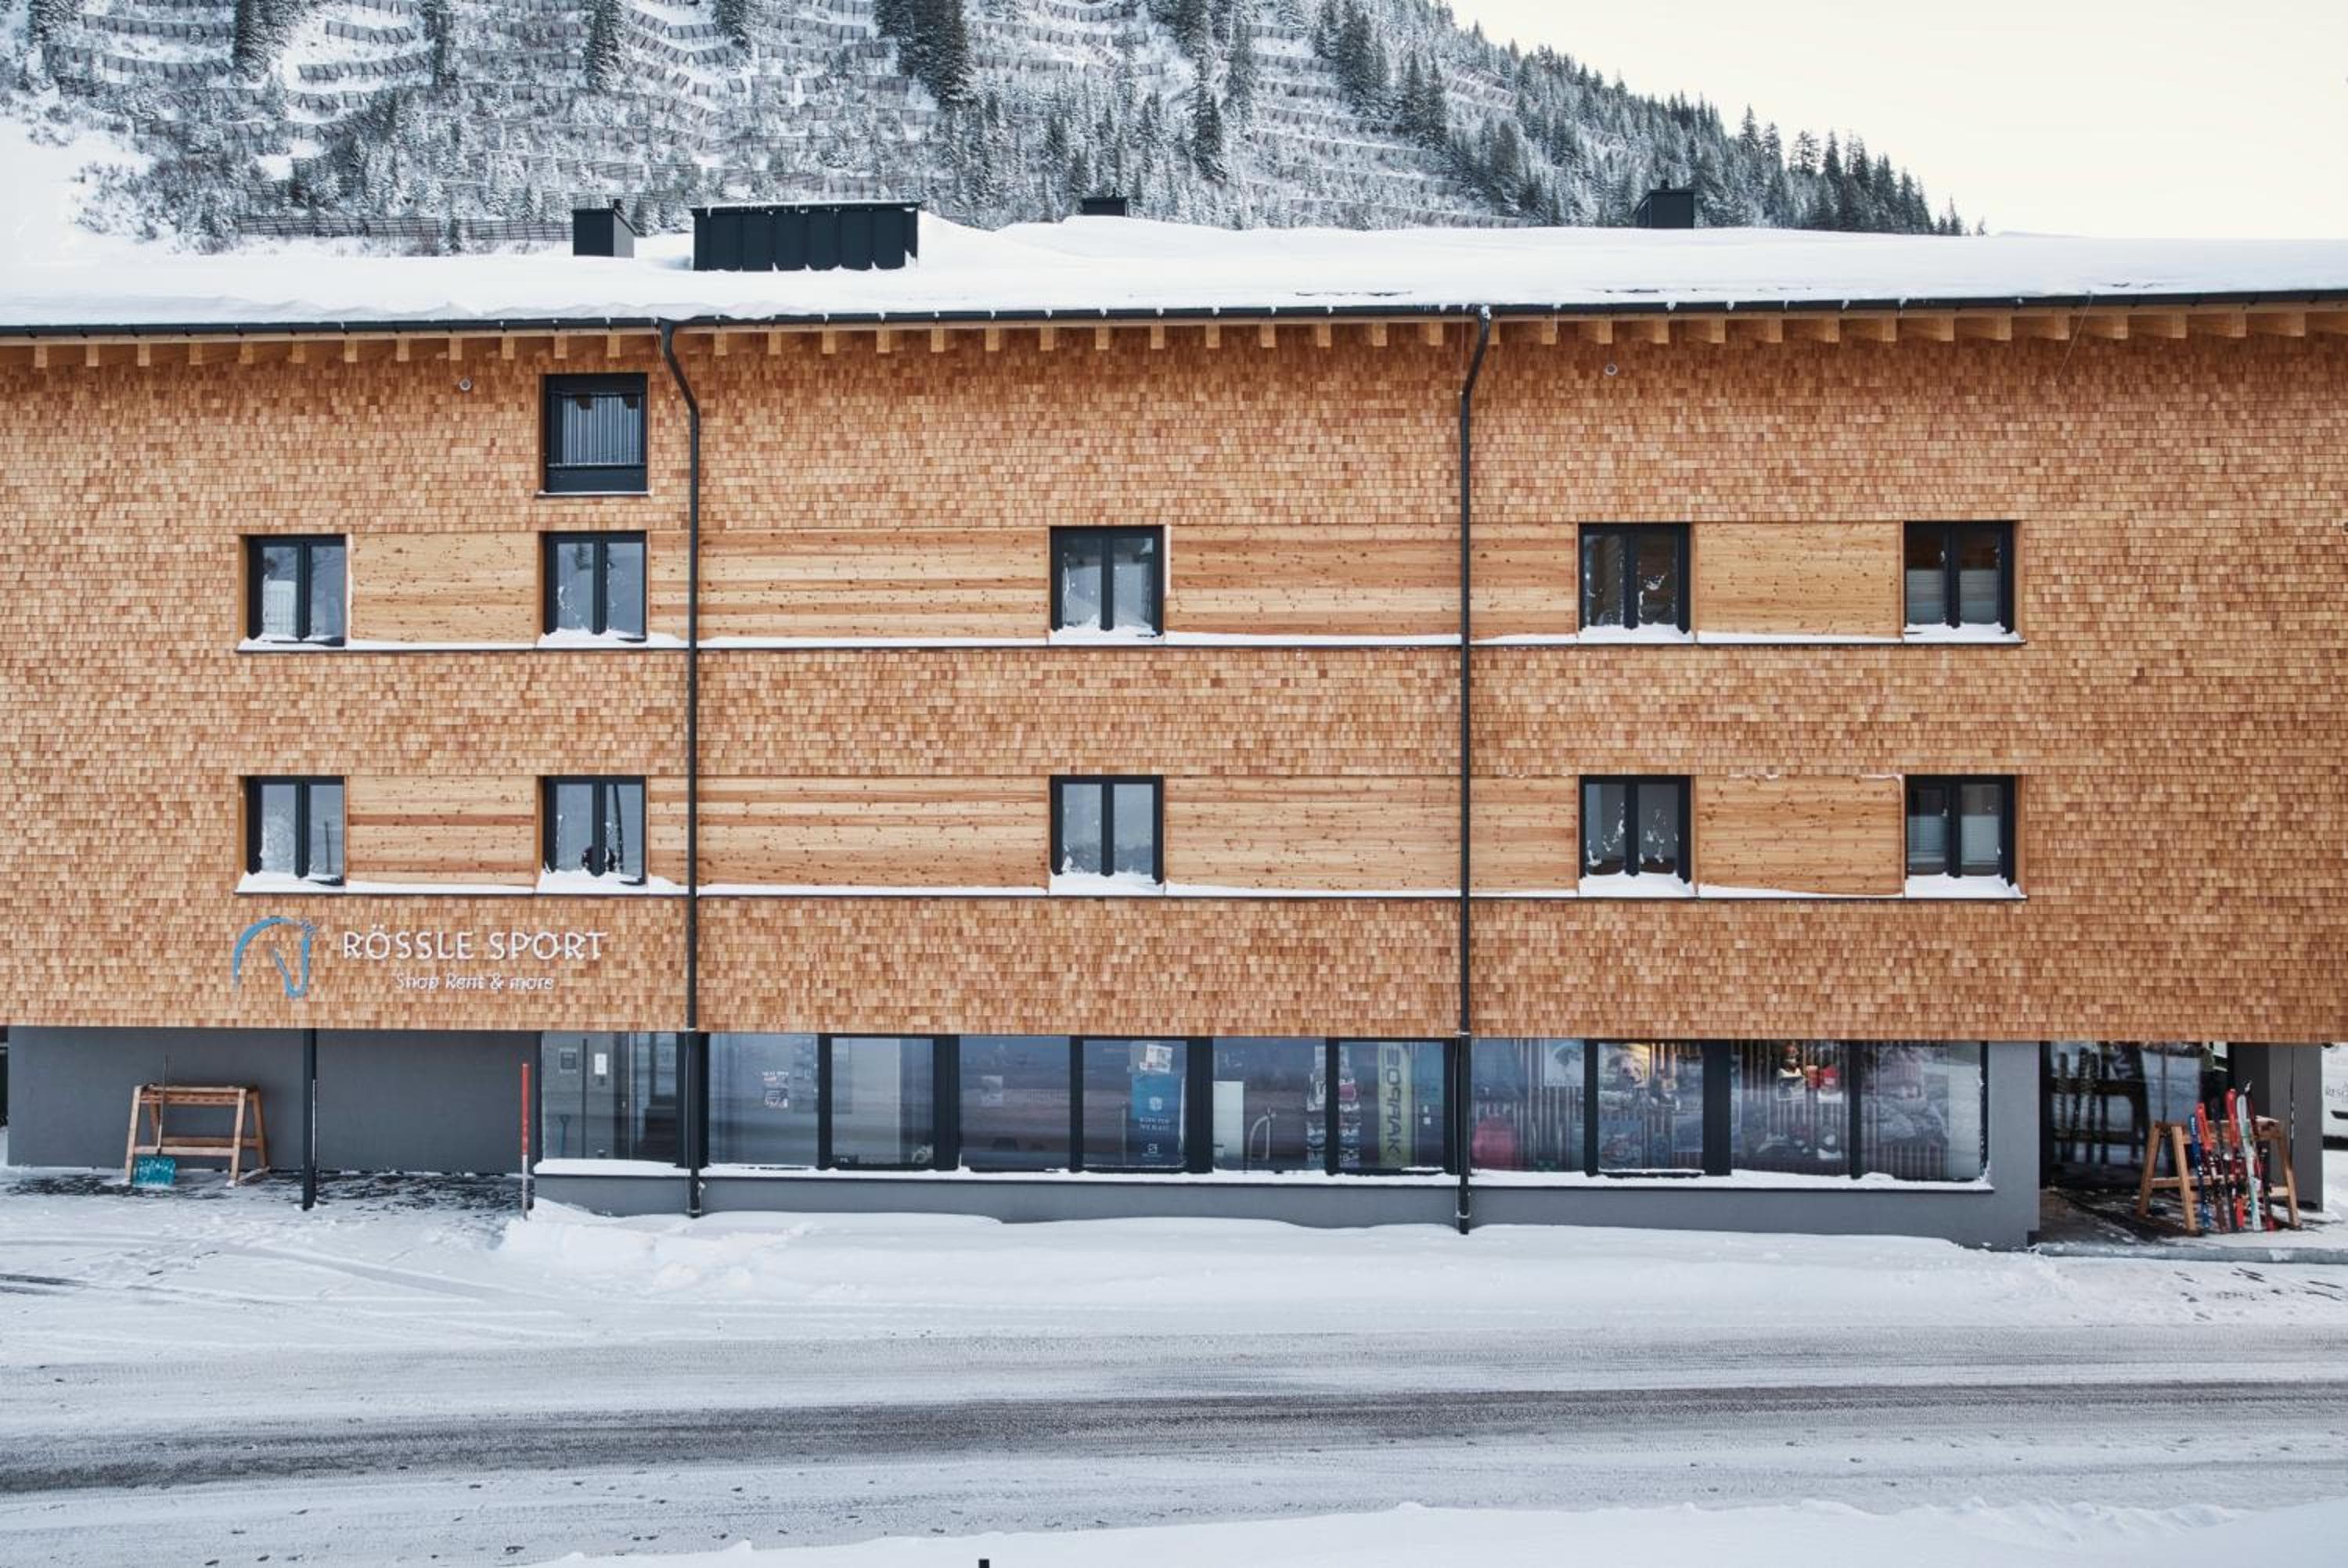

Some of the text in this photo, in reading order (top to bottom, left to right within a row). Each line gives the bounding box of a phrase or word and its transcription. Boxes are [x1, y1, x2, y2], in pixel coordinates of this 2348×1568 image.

[343, 924, 609, 960] RÖSSLE SPORT
[394, 972, 554, 992] Shop Rent & more
